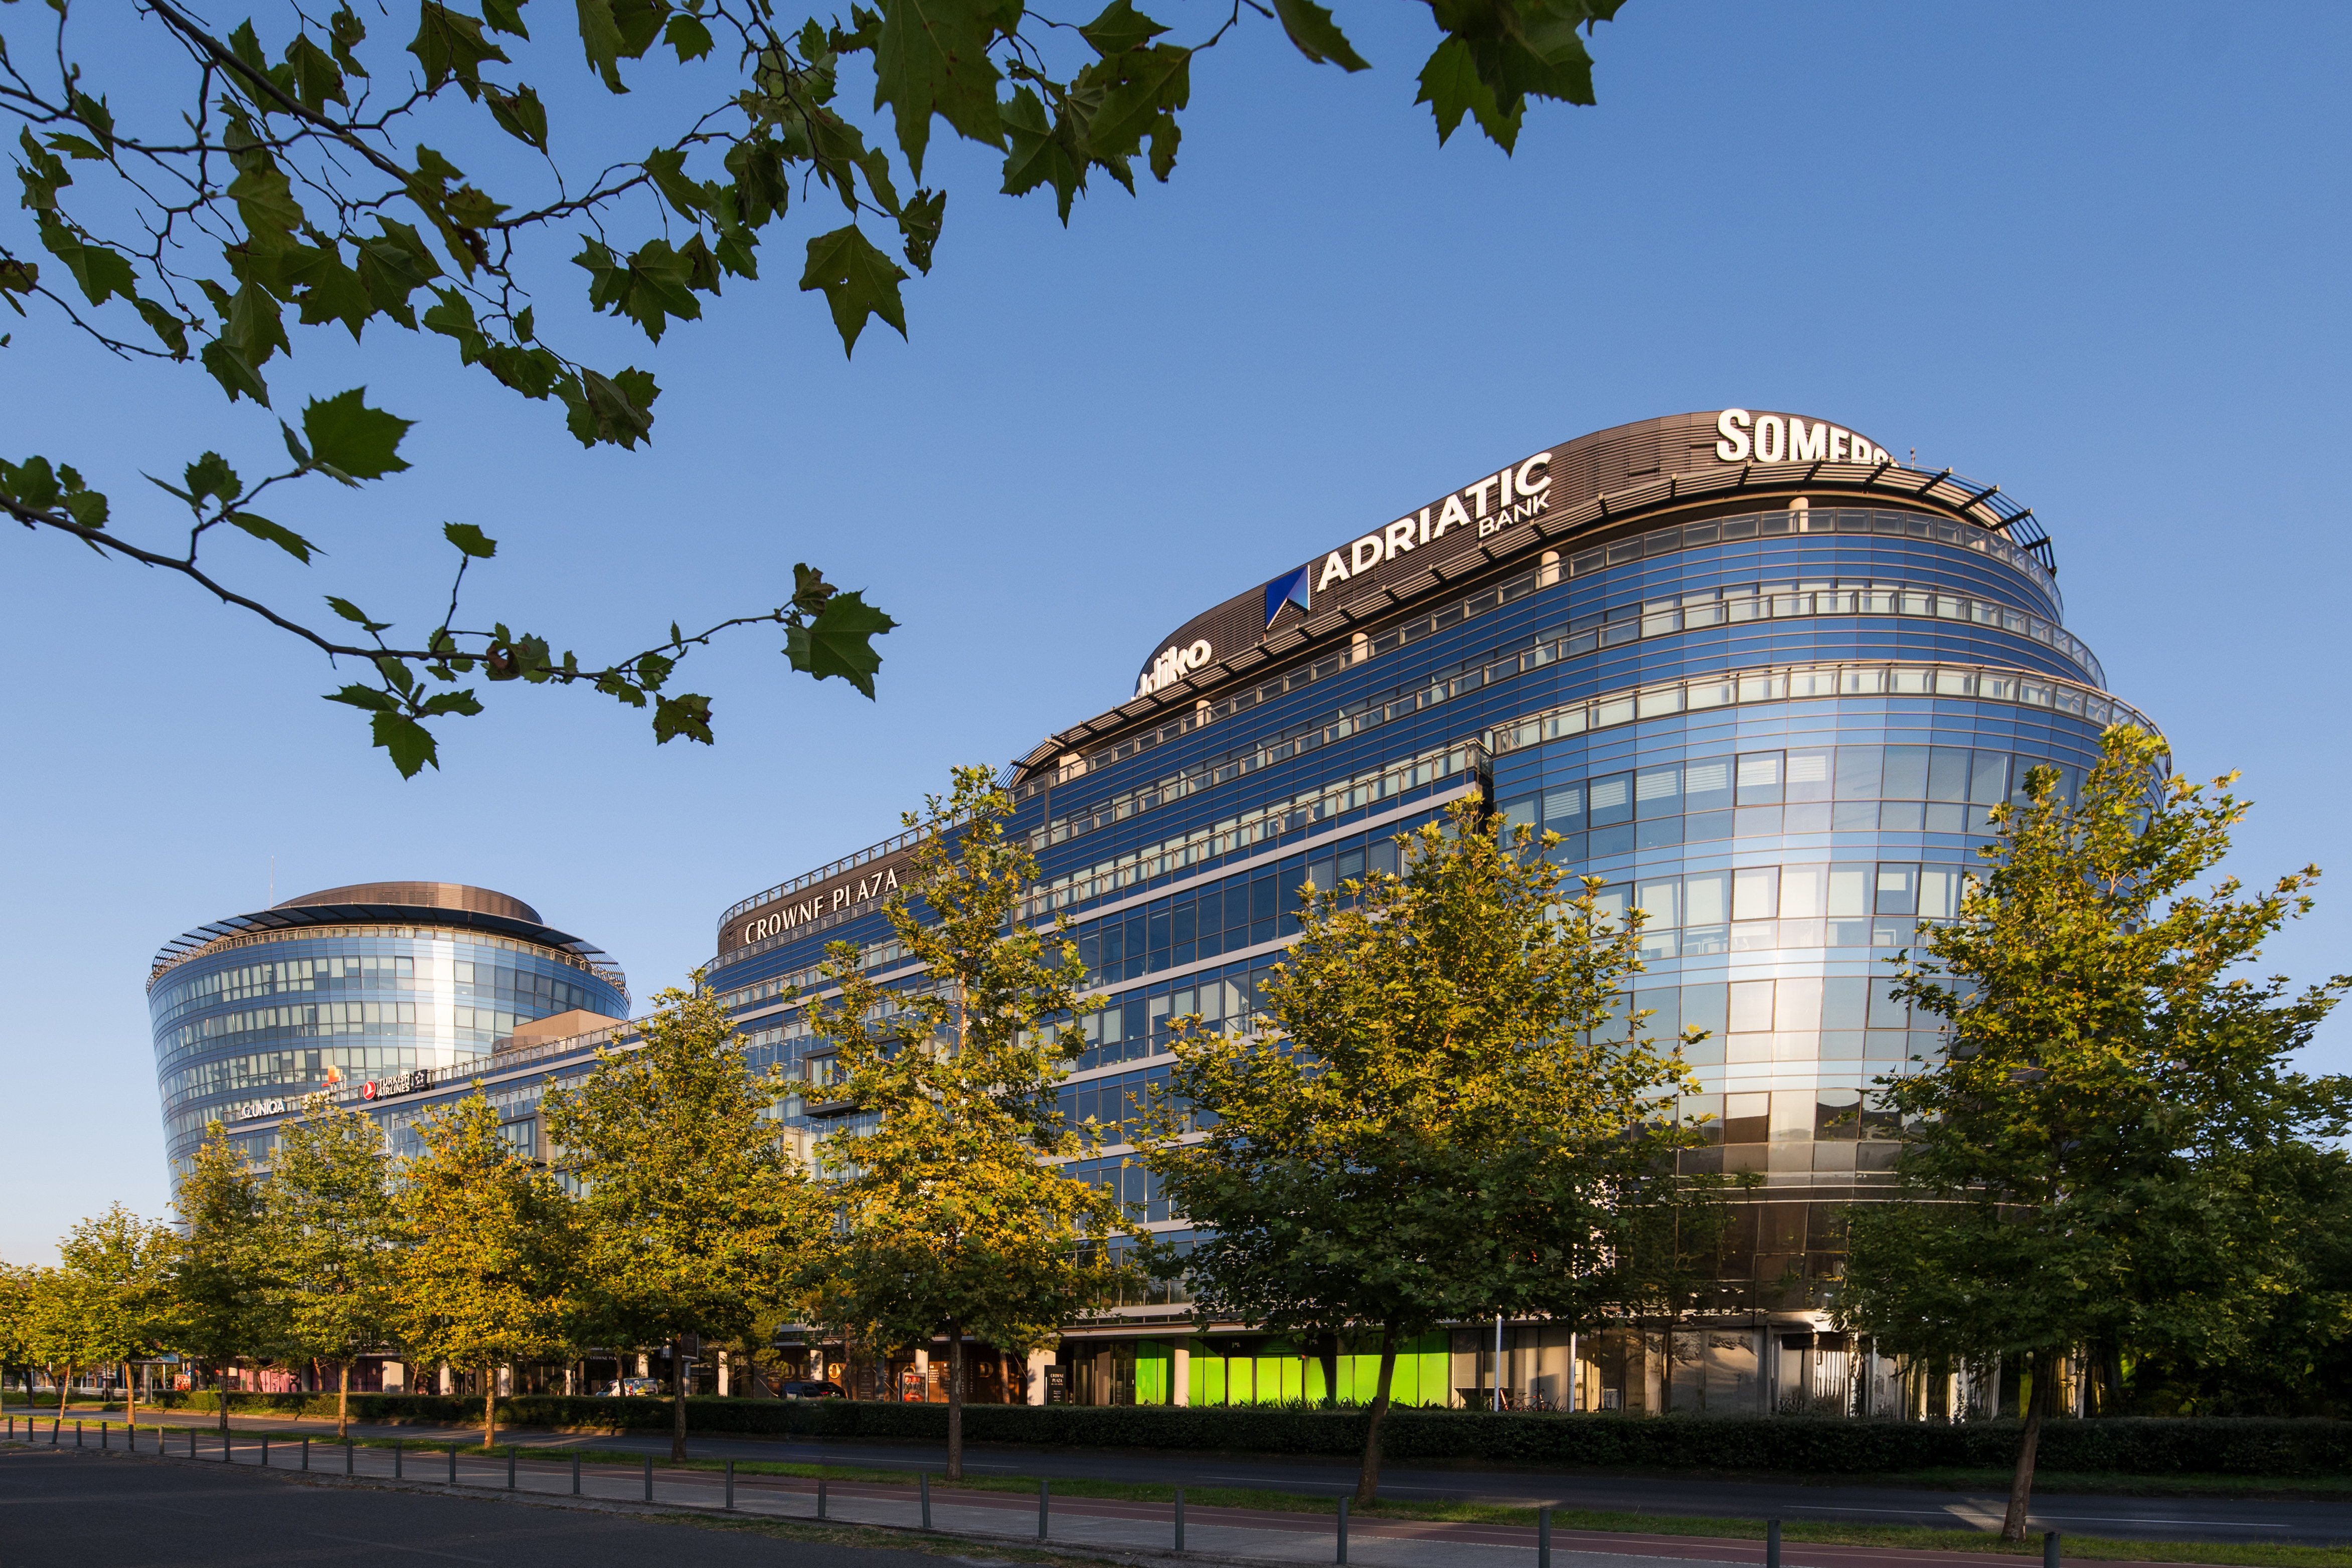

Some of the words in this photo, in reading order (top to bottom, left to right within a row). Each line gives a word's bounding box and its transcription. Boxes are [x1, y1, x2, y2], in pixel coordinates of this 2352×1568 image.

[1316, 452, 1553, 593] ADRIATIC
[1479, 489, 1551, 539] BANK
[745, 895, 809, 945] CROWNE
[377, 1083, 410, 1097] AIRLINES
[379, 1073, 410, 1087] TURKISH
